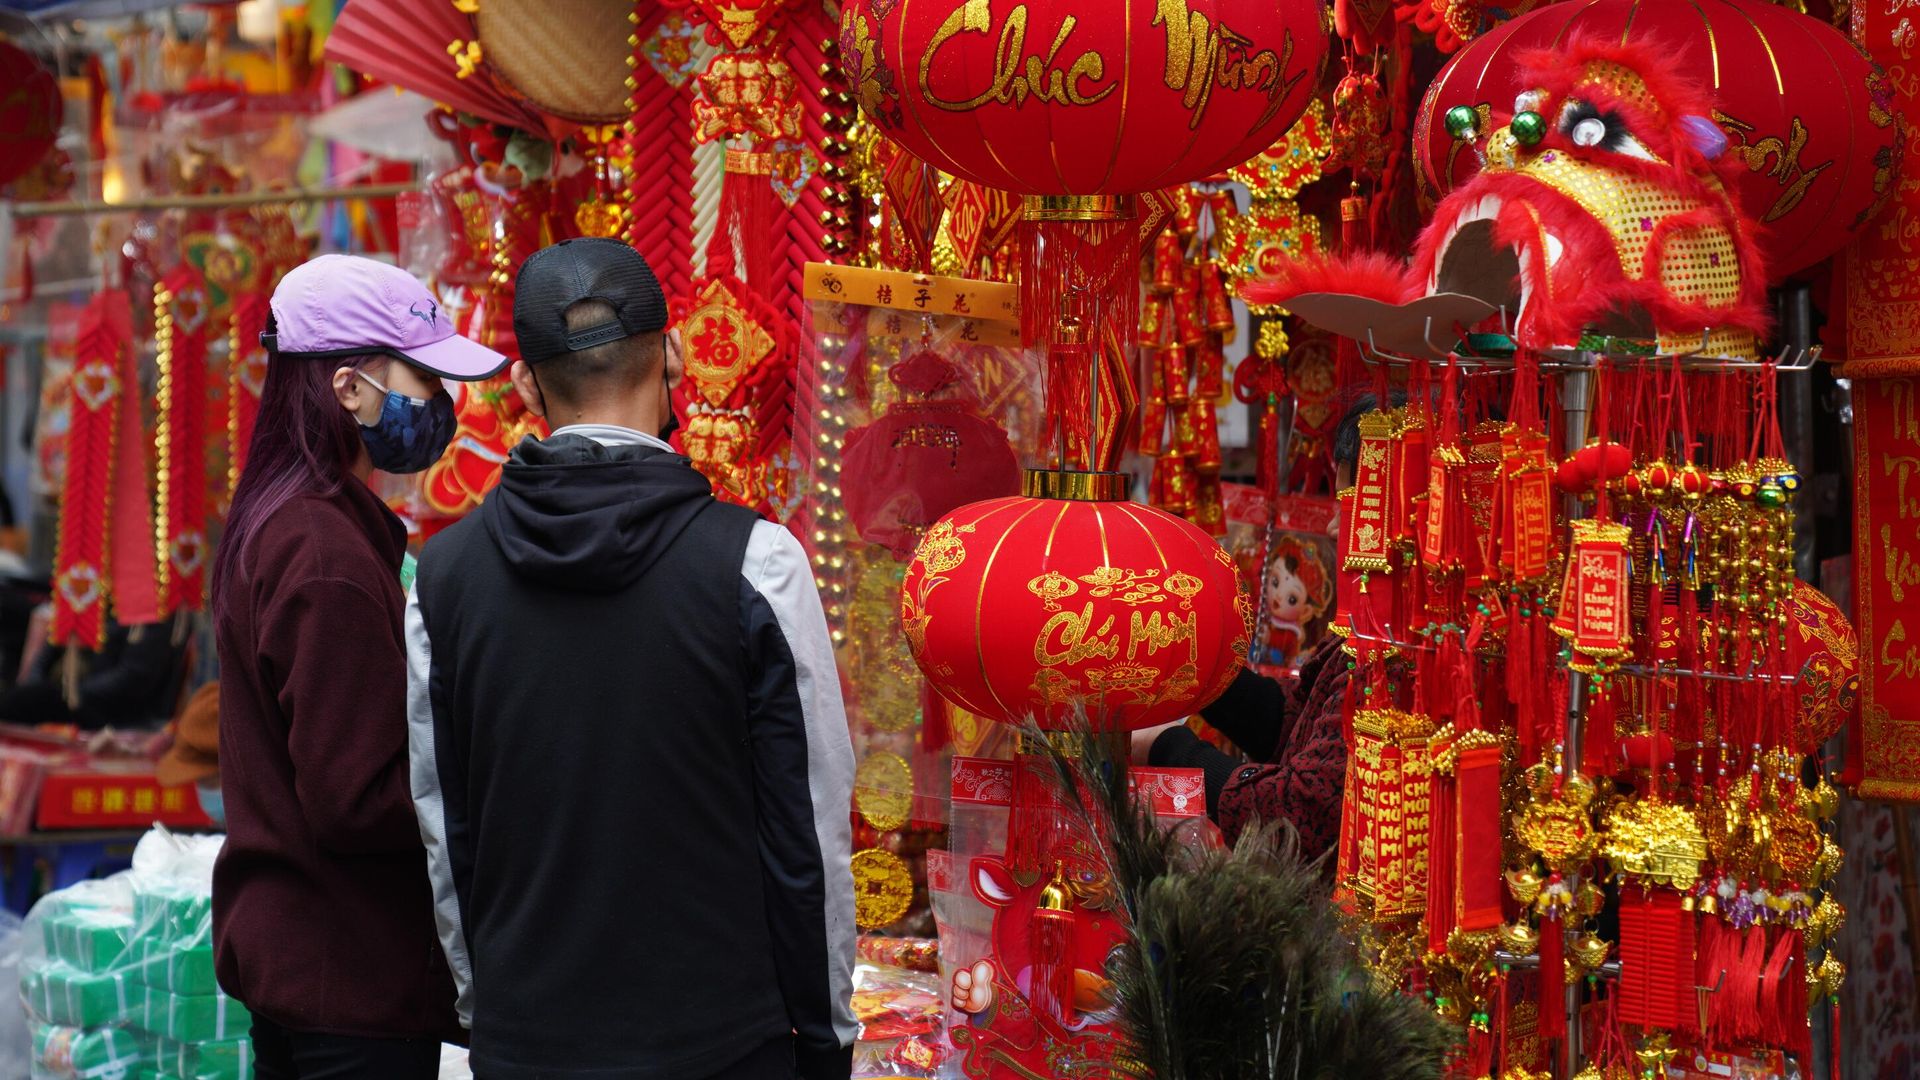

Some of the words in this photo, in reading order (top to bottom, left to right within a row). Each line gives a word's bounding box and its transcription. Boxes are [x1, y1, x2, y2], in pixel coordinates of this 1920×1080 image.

[919, 0, 1118, 112] Chúc
[691, 316, 740, 368] 福
[1592, 582, 1607, 593] An
[1584, 593, 1615, 607] Khang
[1584, 606, 1613, 619] Thịnh
[1583, 618, 1614, 632] Vượng
[1359, 801, 1375, 818] NH
